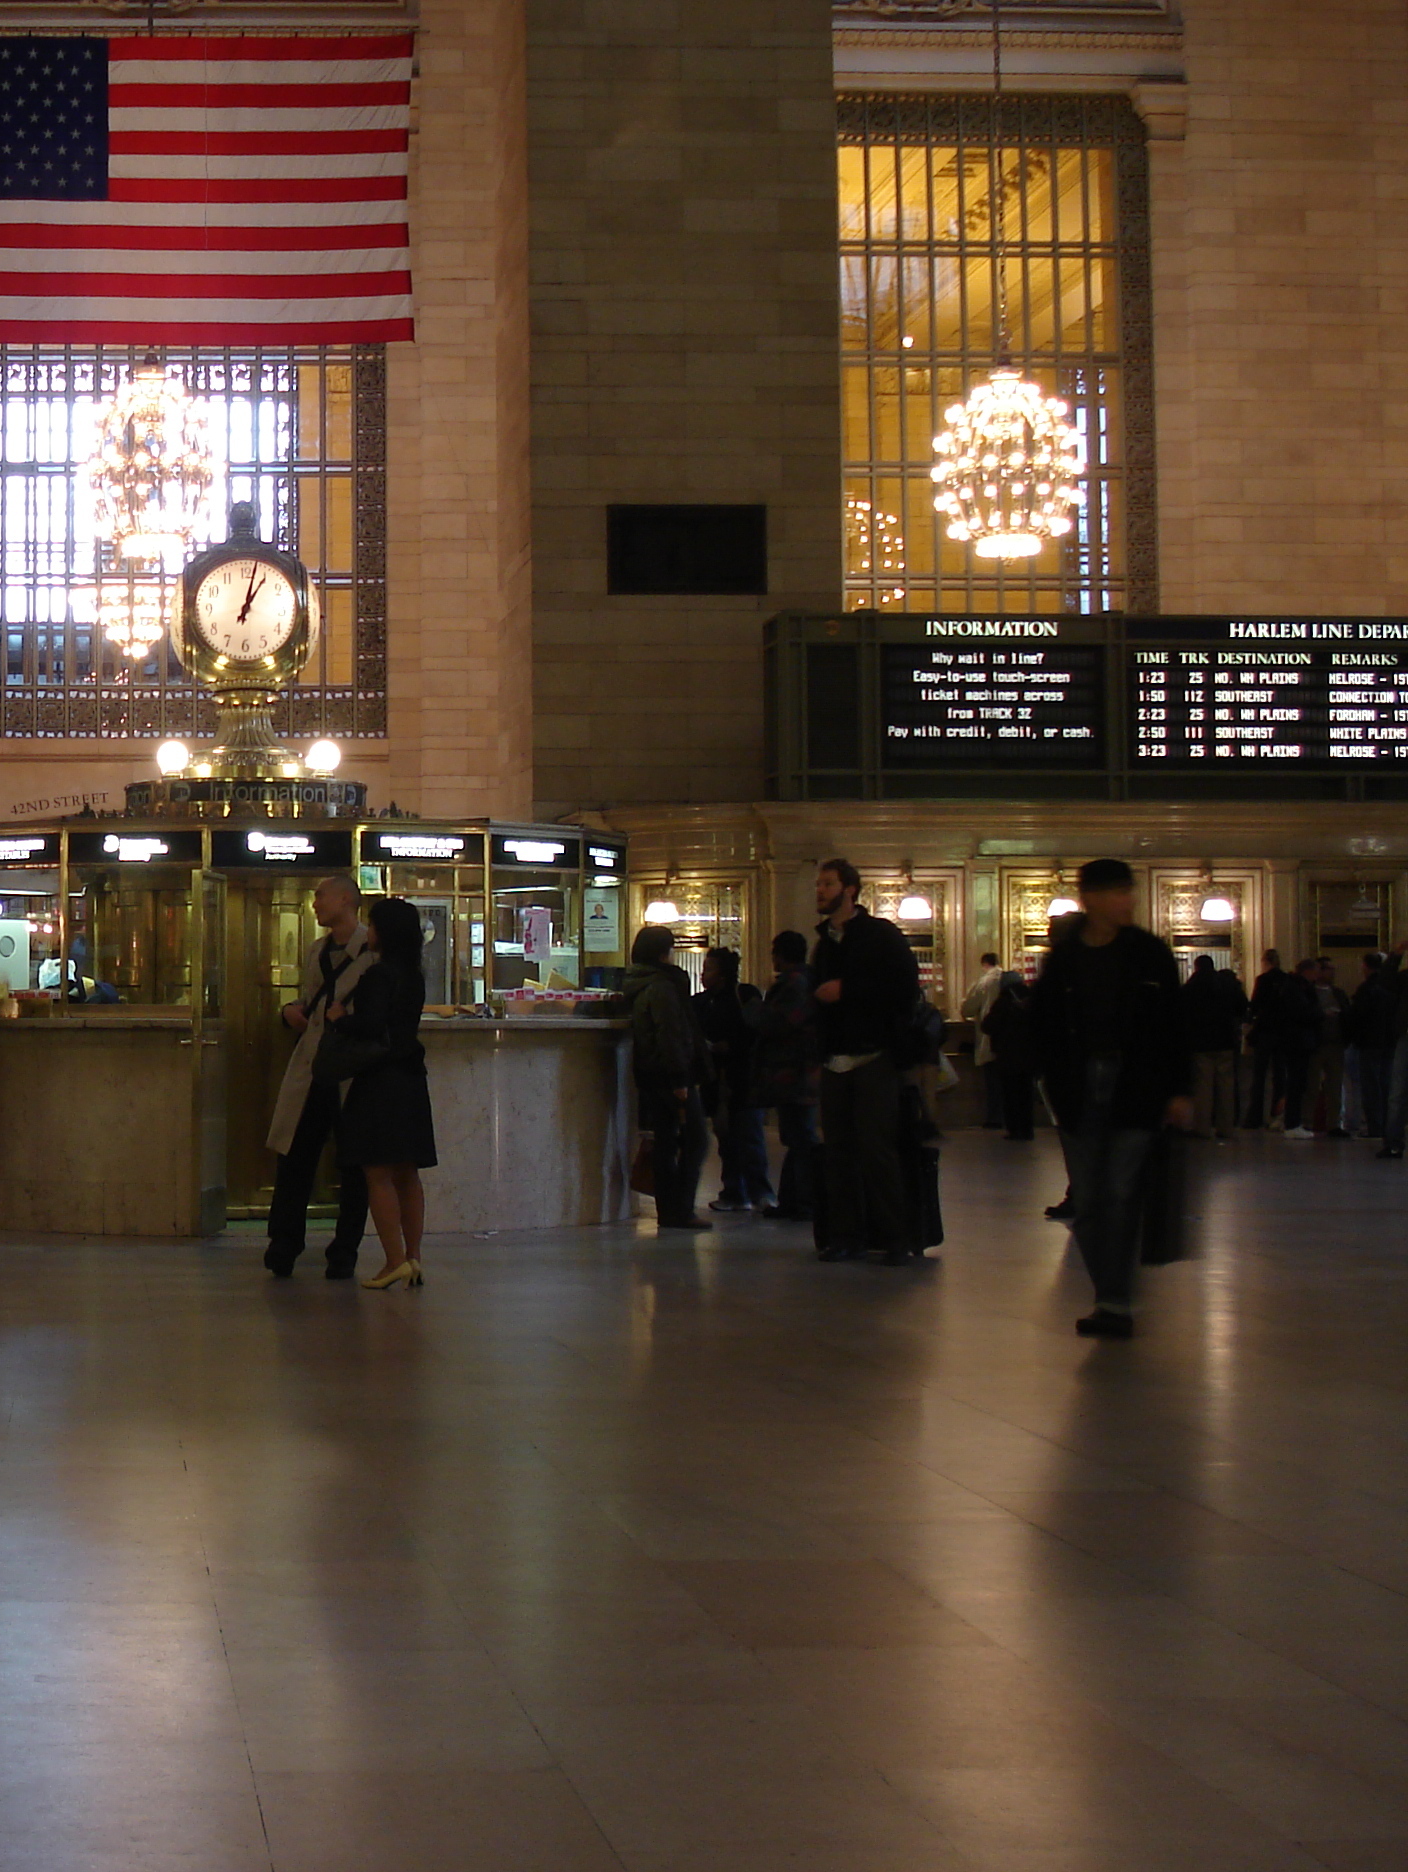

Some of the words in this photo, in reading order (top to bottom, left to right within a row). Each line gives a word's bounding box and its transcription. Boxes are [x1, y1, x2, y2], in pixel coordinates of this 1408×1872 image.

[224, 573, 231, 584] 11
[241, 567, 252, 578] 12
[209, 586, 219, 597] 10
[275, 584, 281, 596] 2
[206, 604, 213, 617] 9
[211, 623, 217, 635] 8
[274, 623, 281, 635] 4
[926, 621, 1057, 636] INFORMATION
[1230, 623, 1306, 638] HARLEM
[1313, 624, 1353, 638] LINE
[224, 635, 231, 647] 7
[242, 639, 249, 652] 6
[259, 636, 267, 648] 5
[932, 653, 953, 665] Why
[958, 653, 984, 664] wait
[993, 653, 1005, 664] in
[1012, 653, 1044, 664] line?
[1135, 652, 1169, 663] TIME
[1179, 653, 1209, 663] TRK
[1218, 653, 1311, 664] DESTINATION
[1332, 654, 1397, 665] REMARKS
[913, 670, 986, 683] Easy-to-use
[993, 672, 1070, 683] touch-screen
[1139, 672, 1165, 683] 1:23
[1189, 672, 1203, 683] 25
[1215, 672, 1232, 683] NO.
[1240, 673, 1254, 684] WH
[1259, 673, 1299, 684] PLAINS
[1329, 673, 1375, 685] MELROSE
[921, 689, 958, 700] ticket
[966, 690, 1018, 701] machines
[1024, 692, 1064, 701] across
[1140, 690, 1165, 701] 1:50
[1185, 690, 1204, 702] 112
[1215, 691, 1274, 702] SOUTHEAST
[1329, 691, 1396, 703] CONNECTION
[948, 708, 973, 719] from
[979, 708, 1012, 719] TRACK
[1018, 708, 1031, 719] 32
[1138, 708, 1165, 720] 2:23
[1190, 709, 1204, 720] 25
[1215, 709, 1233, 720] NO.
[1241, 709, 1255, 720] WH
[1260, 709, 1300, 720] PLAINS
[1329, 709, 1376, 721] FORDHAM
[888, 726, 908, 738] Pay
[914, 726, 940, 737] with
[946, 726, 991, 739] credit,
[998, 726, 1036, 739] debit,
[1044, 728, 1058, 737] or
[1063, 727, 1093, 737] cash.
[1139, 727, 1166, 738] 2:50
[1185, 727, 1202, 738] 111
[1216, 727, 1274, 739] SOUTHEAST
[1330, 728, 1363, 739] WHITE
[1368, 728, 1407, 739] PLAINS
[1139, 745, 1166, 756] 3:23
[1190, 745, 1204, 756] 25
[1216, 745, 1234, 757] NO.
[1241, 745, 1256, 757] WH
[1260, 745, 1300, 757] PLAINS
[1330, 746, 1376, 757] MELROSE
[210, 784, 325, 802] Information
[11, 800, 49, 814] 42ND
[54, 793, 108, 808] STREET
